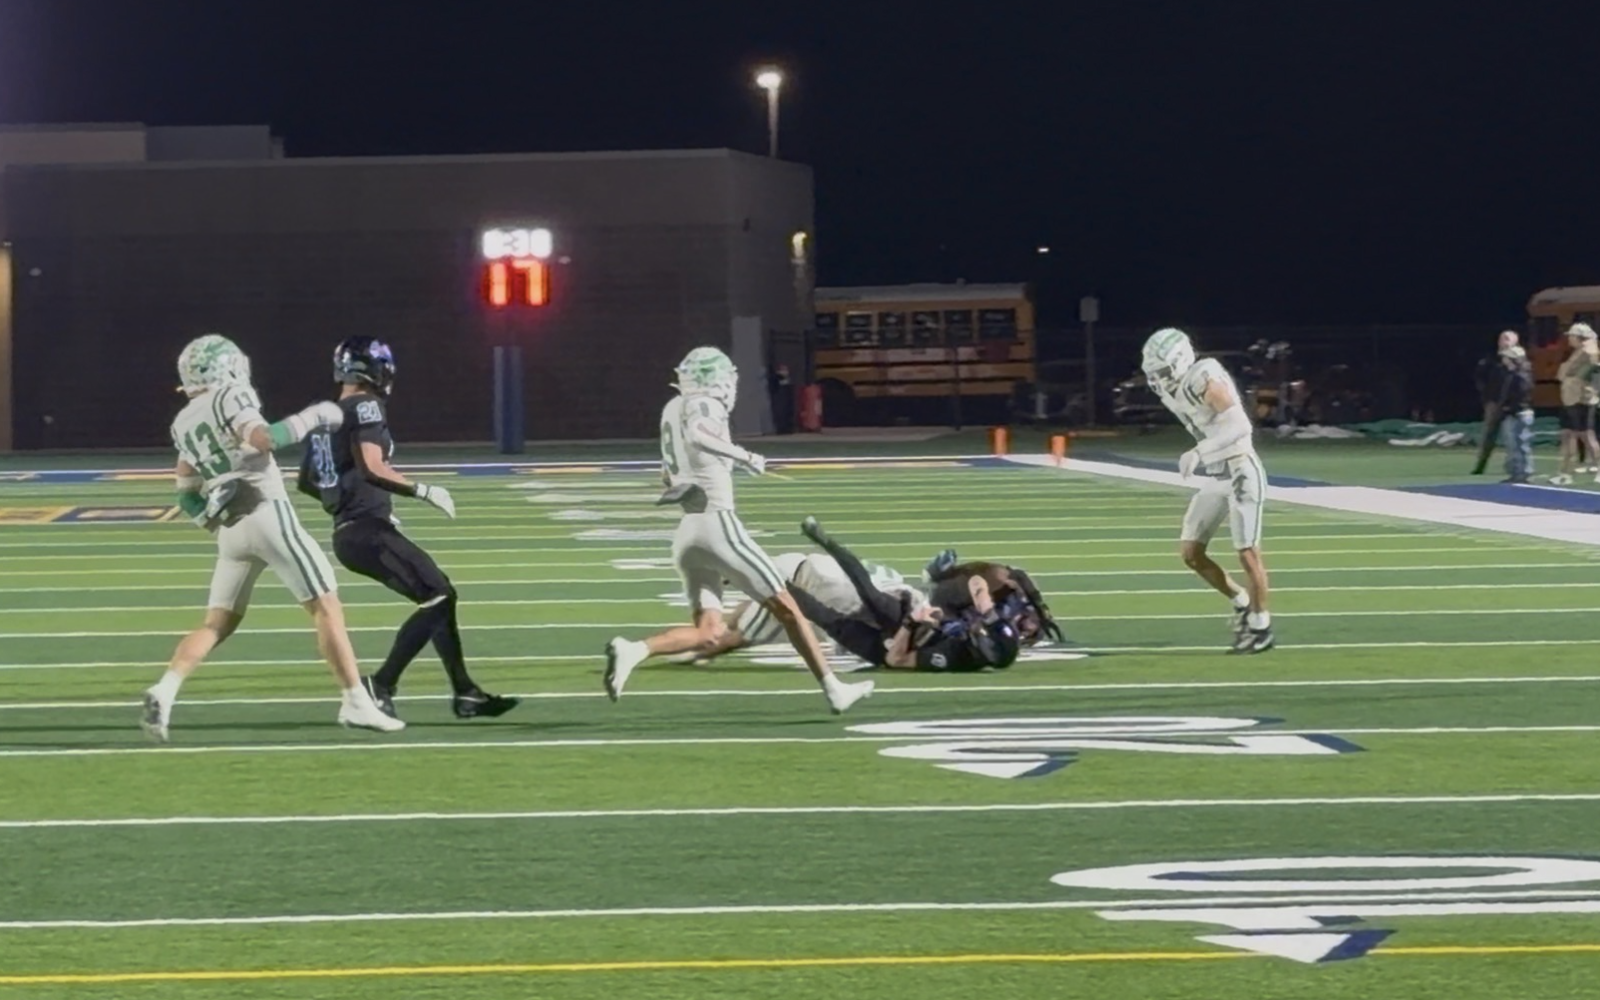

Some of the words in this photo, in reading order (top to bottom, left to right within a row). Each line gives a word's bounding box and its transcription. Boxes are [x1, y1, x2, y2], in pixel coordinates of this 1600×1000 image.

[490, 261, 547, 306] 17
[356, 400, 382, 424] 21
[185, 421, 232, 481] 13
[845, 715, 1365, 762] 20
